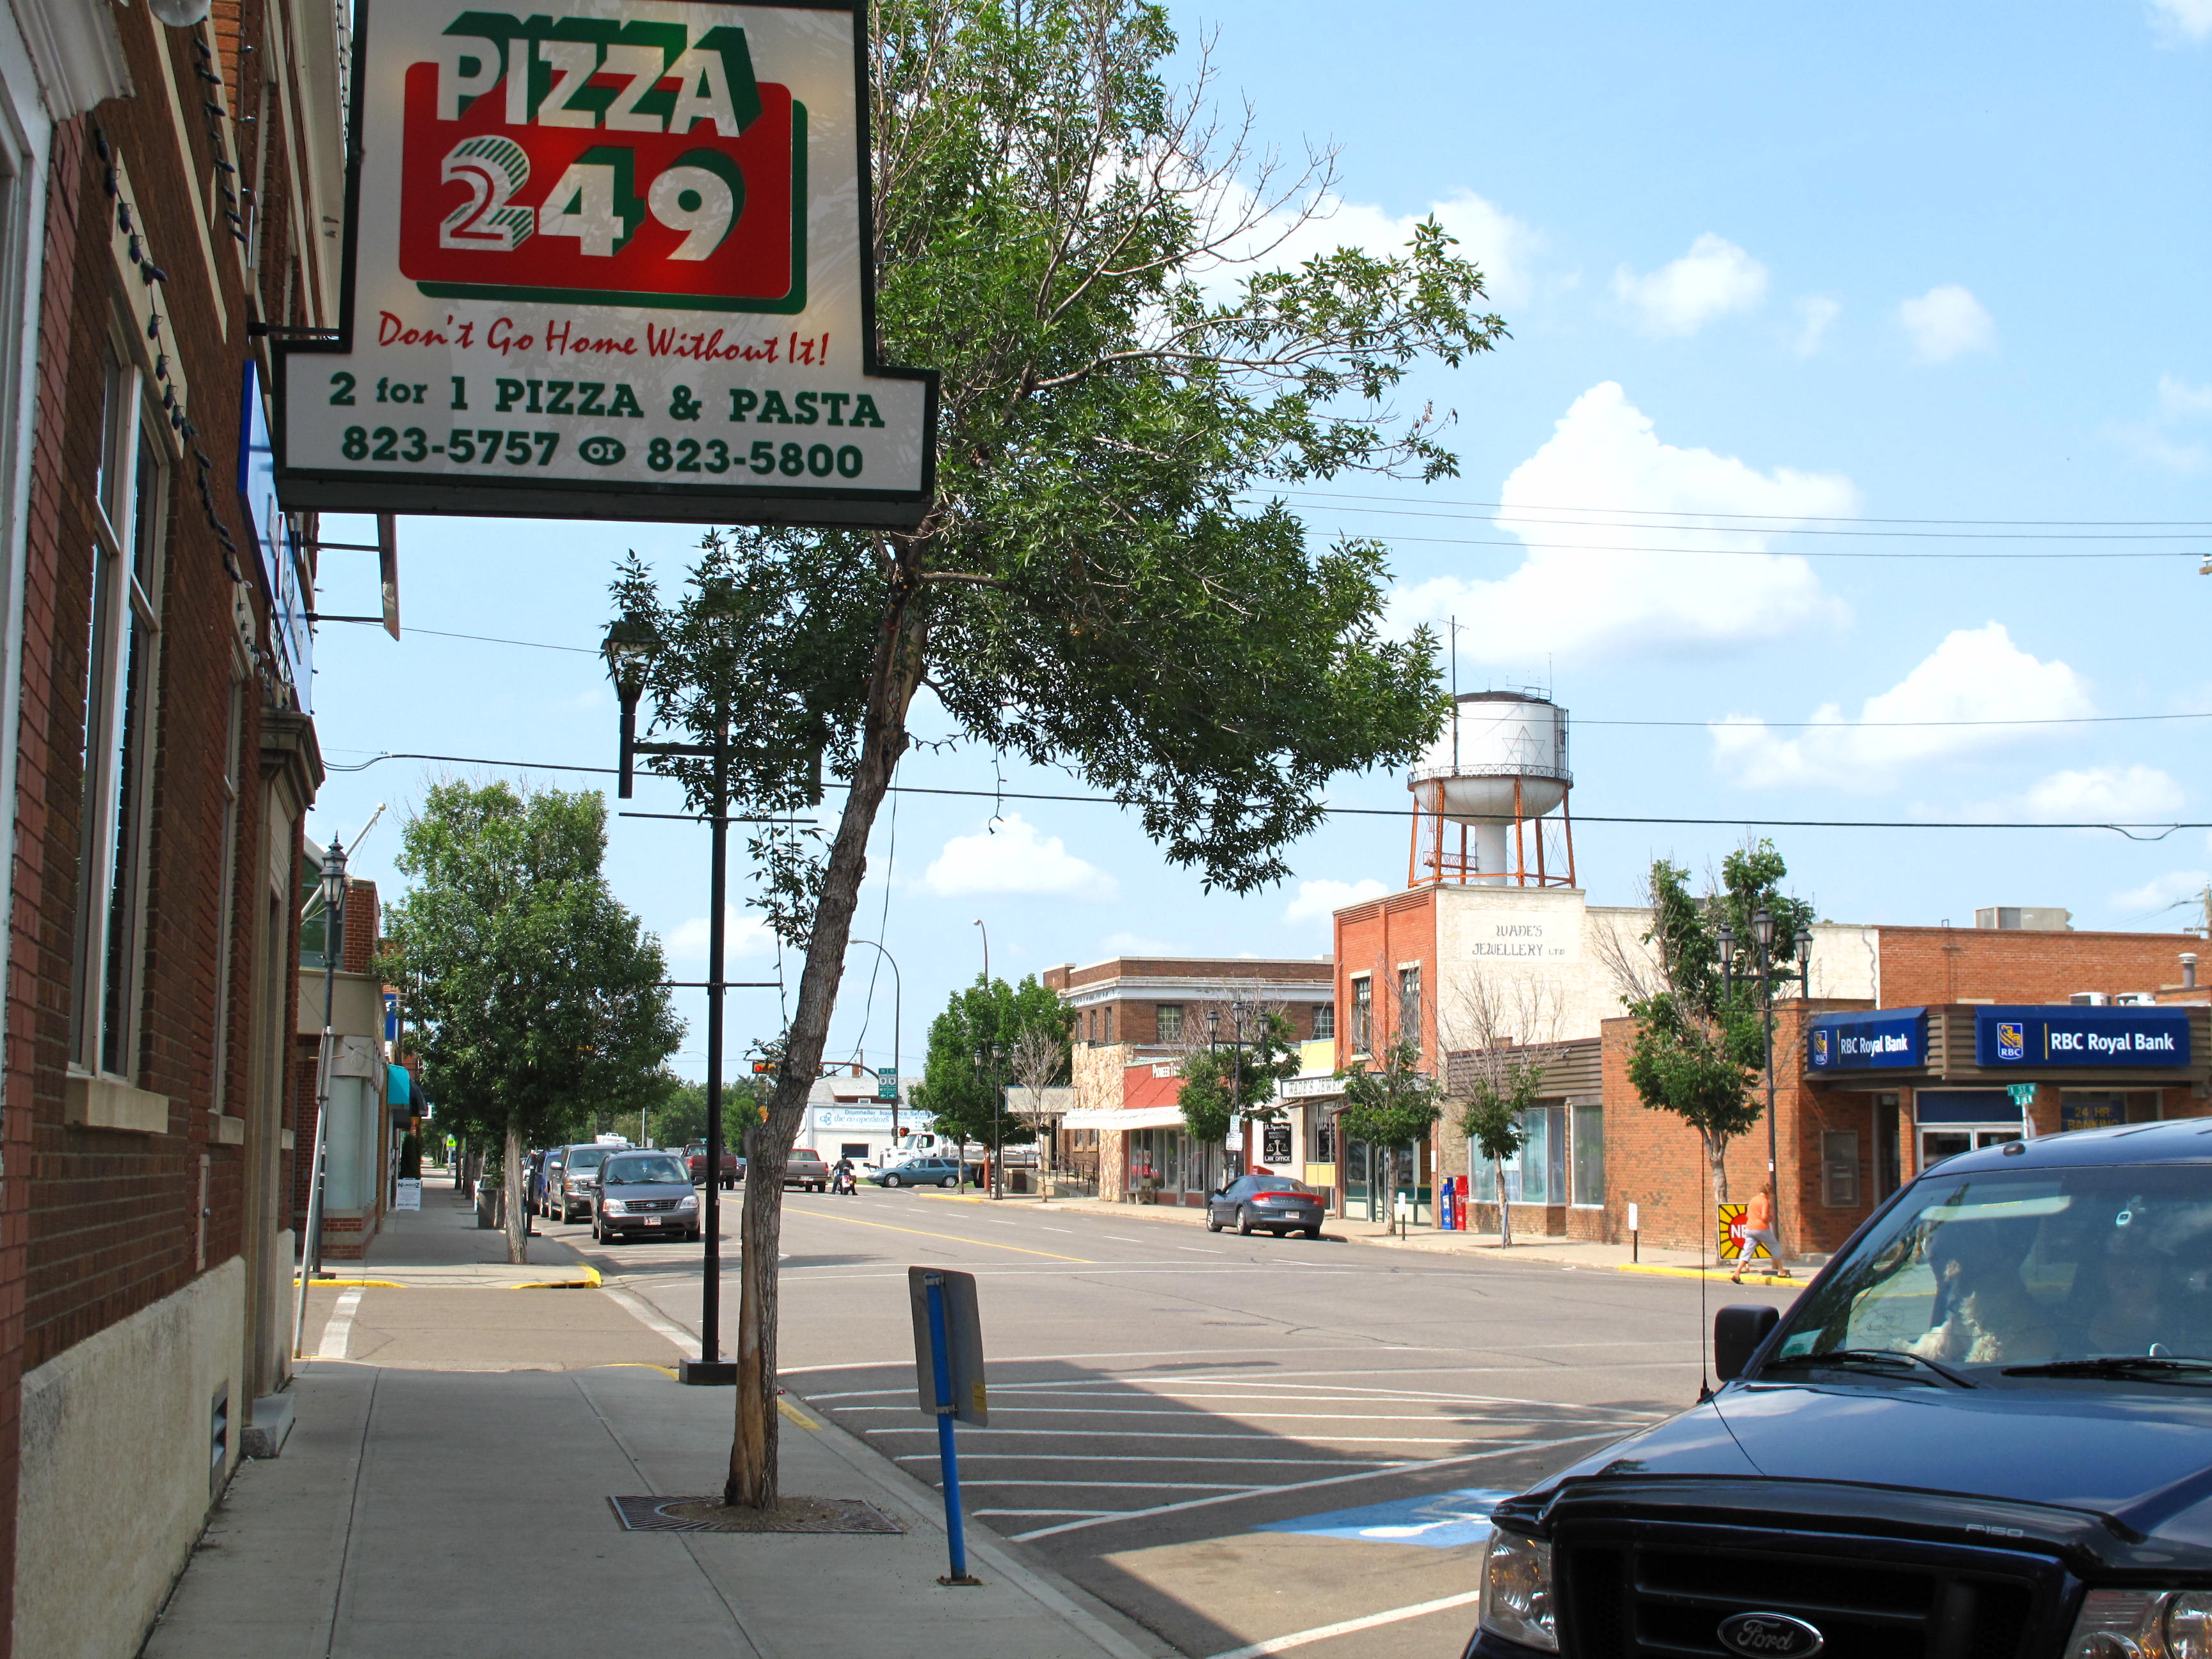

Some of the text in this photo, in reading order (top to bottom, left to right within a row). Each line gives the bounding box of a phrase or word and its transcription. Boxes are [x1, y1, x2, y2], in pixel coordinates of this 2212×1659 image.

[437, 12, 762, 138] PIZZA
[440, 134, 746, 261] 249
[379, 310, 830, 366] Don't Go Home Without It!
[329, 371, 885, 428] 2 for 1 PIZZA & PASTA
[341, 425, 561, 467] 823-5757
[646, 437, 863, 479] 823-5800
[1496, 924, 1543, 937] WADE'S
[1471, 942, 1543, 956] JEWELLERY
[1840, 1033, 1909, 1057] RBC Royal Bank
[2000, 1048, 2021, 1056] RBC
[2050, 1032, 2175, 1055] RBC Royal Bank
[1731, 1224, 1747, 1238] NE
[1736, 1619, 1795, 1651] Ford
